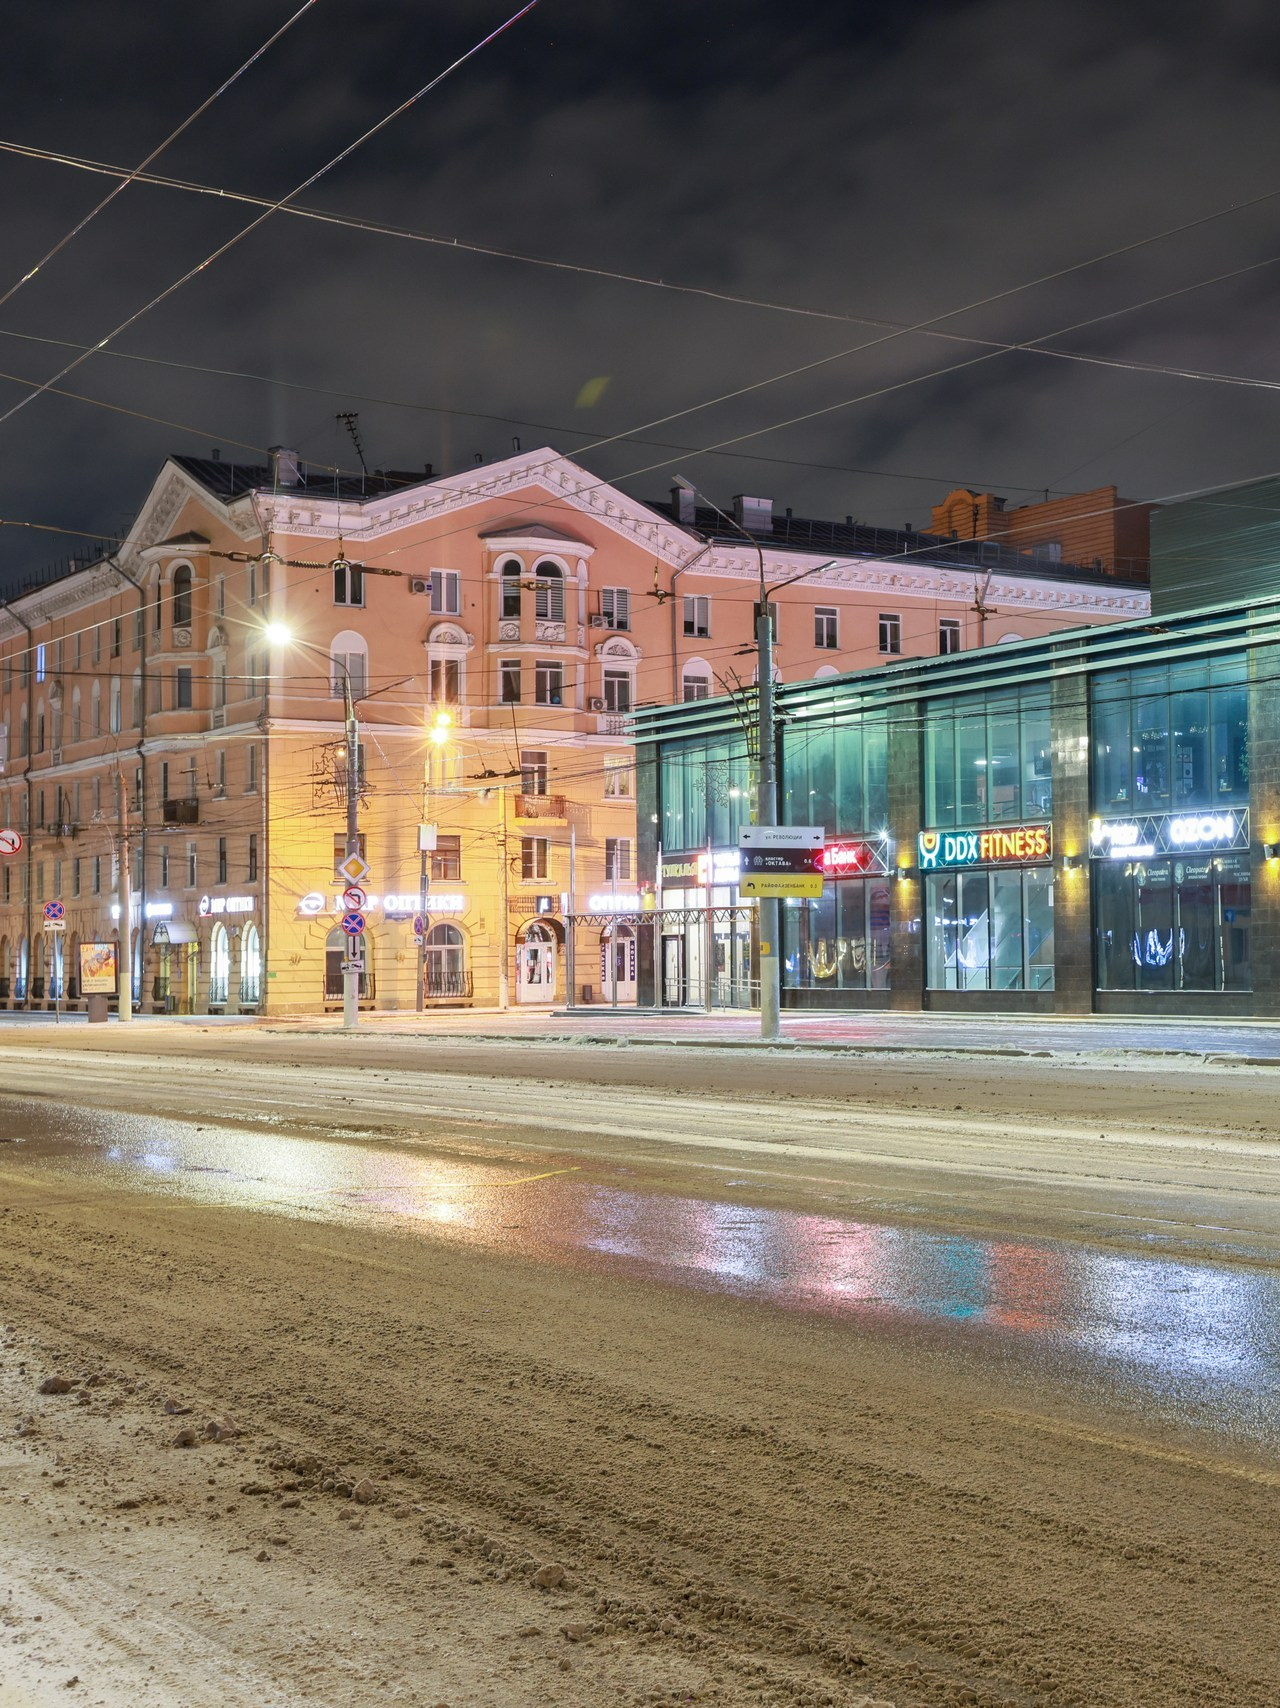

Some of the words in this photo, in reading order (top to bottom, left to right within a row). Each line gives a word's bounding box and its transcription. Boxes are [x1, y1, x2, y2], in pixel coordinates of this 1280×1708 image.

[1171, 815, 1234, 844] OZON
[831, 848, 857, 864] Банк
[945, 834, 978, 861] DDX
[980, 829, 1047, 858] FITNESS
[335, 895, 379, 911] МР
